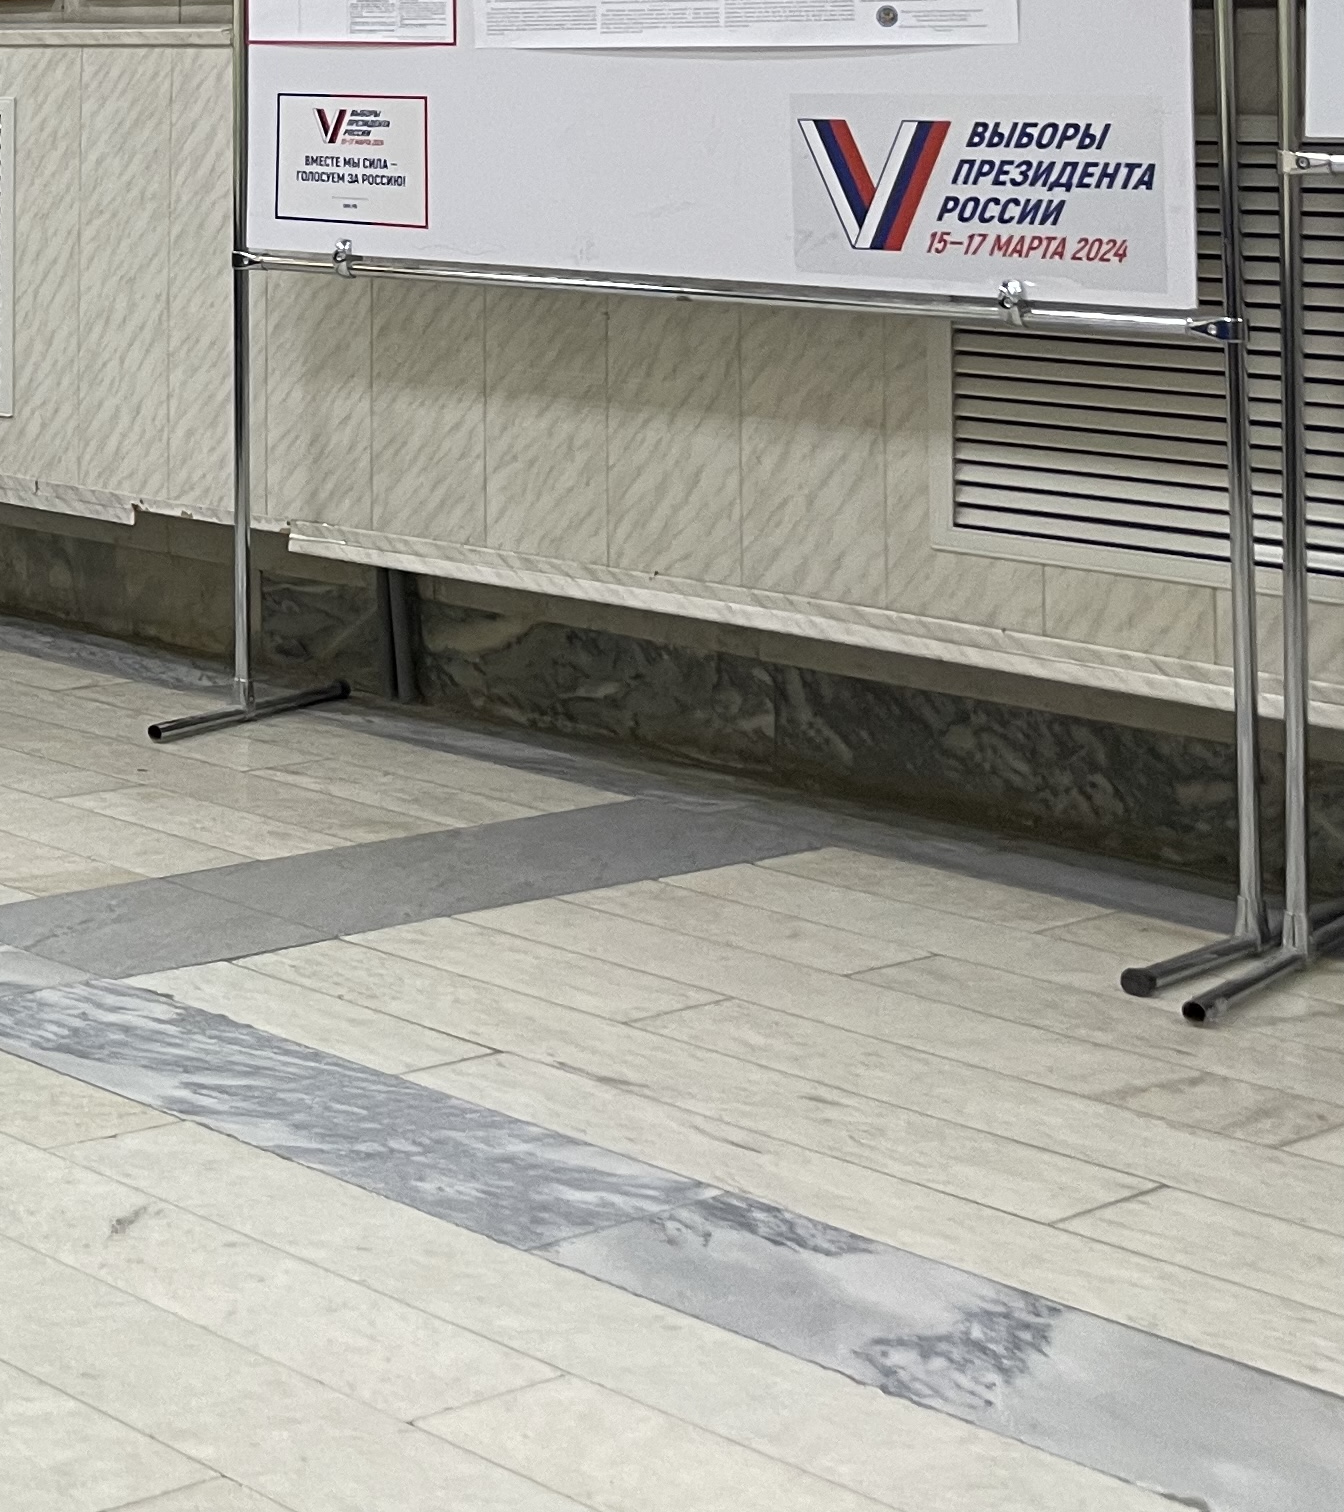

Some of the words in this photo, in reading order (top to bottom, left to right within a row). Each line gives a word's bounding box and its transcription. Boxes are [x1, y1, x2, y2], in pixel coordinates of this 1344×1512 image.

[965, 121, 1112, 150] ВЫБОРЫ
[304, 155, 341, 167] ВМЕСТЕ
[343, 157, 360, 168] МЫ
[362, 158, 389, 169] СИЛА
[951, 158, 1156, 192] ПРЕЗИДЕНТА
[296, 170, 345, 183] ГОЛОСУЕМ
[347, 173, 359, 184] ЗА
[361, 173, 406, 187] РОССИЮ!
[936, 195, 1066, 226] РОССИИ
[989, 234, 1067, 261] МАРТА
[1070, 237, 1128, 263] 2024
